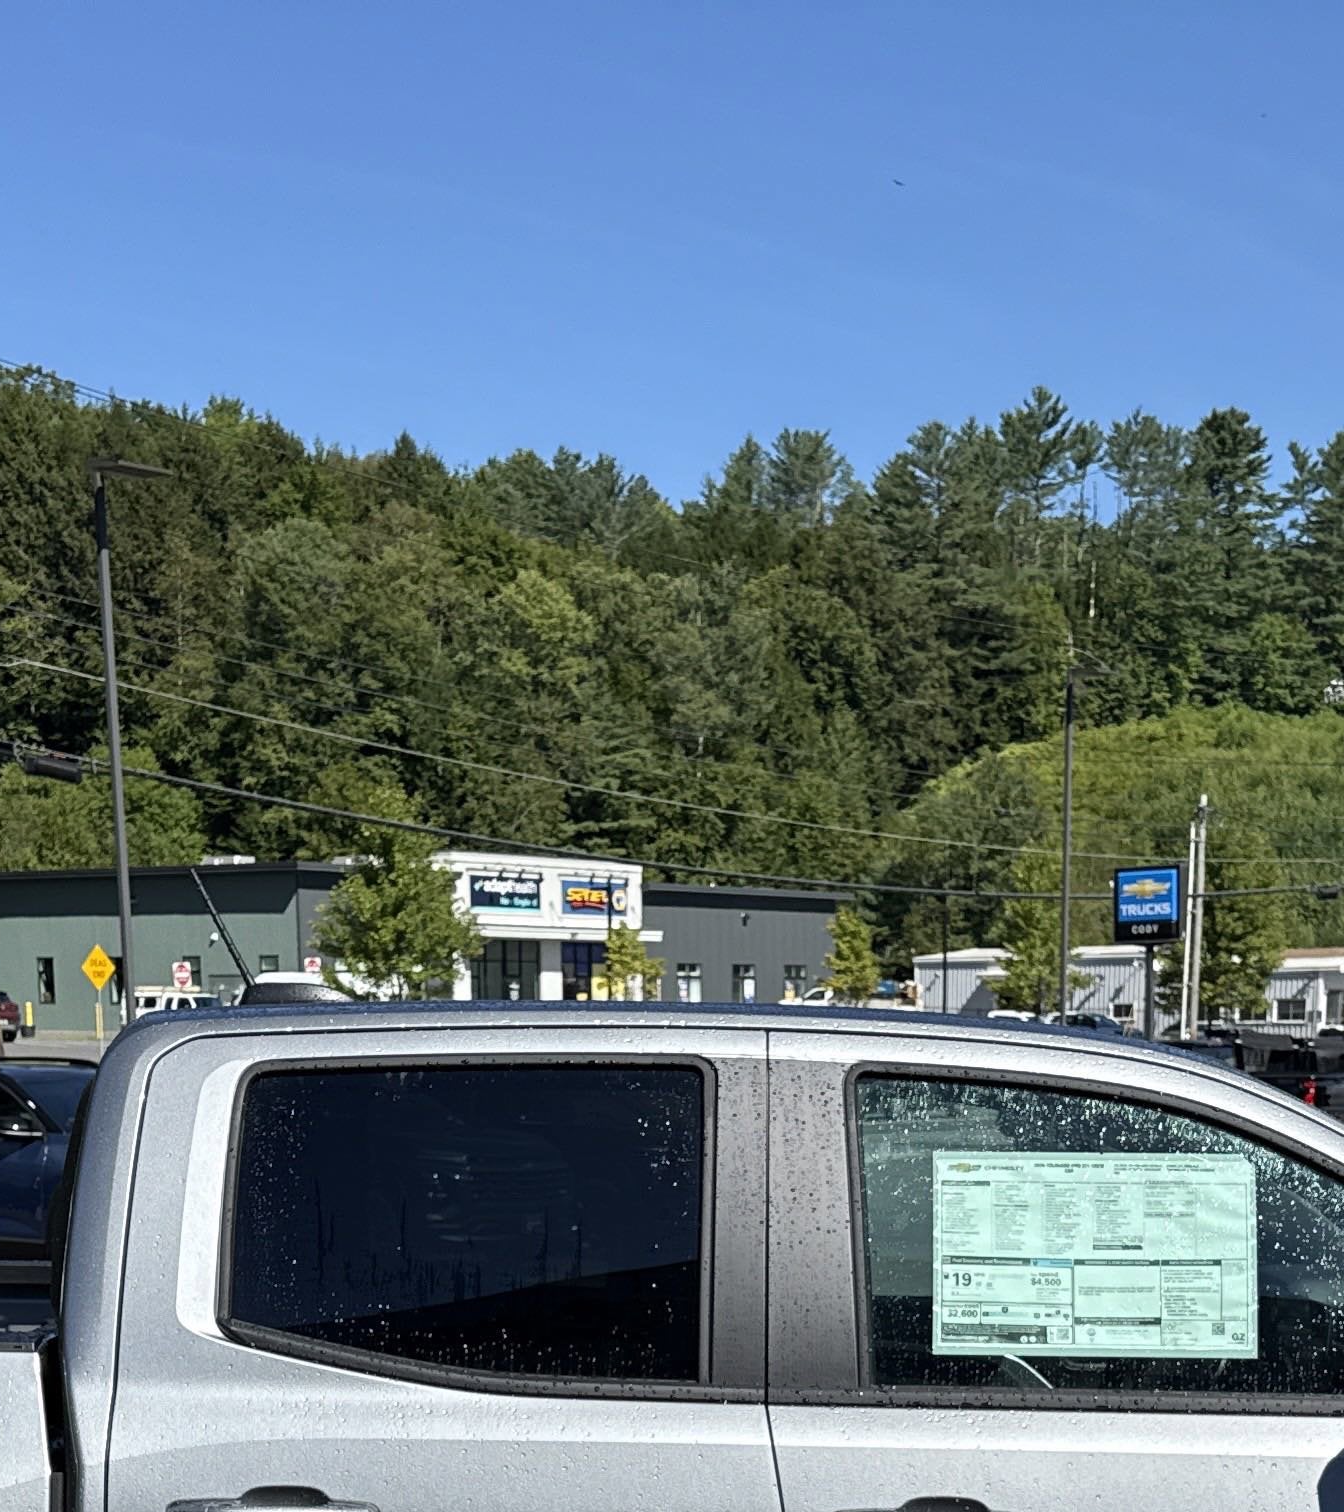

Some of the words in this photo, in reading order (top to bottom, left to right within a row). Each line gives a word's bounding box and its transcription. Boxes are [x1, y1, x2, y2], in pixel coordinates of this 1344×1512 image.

[1120, 902, 1171, 916] TRUCKS
[1131, 924, 1159, 934] CODY
[952, 1272, 972, 1287] 19
[1031, 1278, 1062, 1286] $4,500
